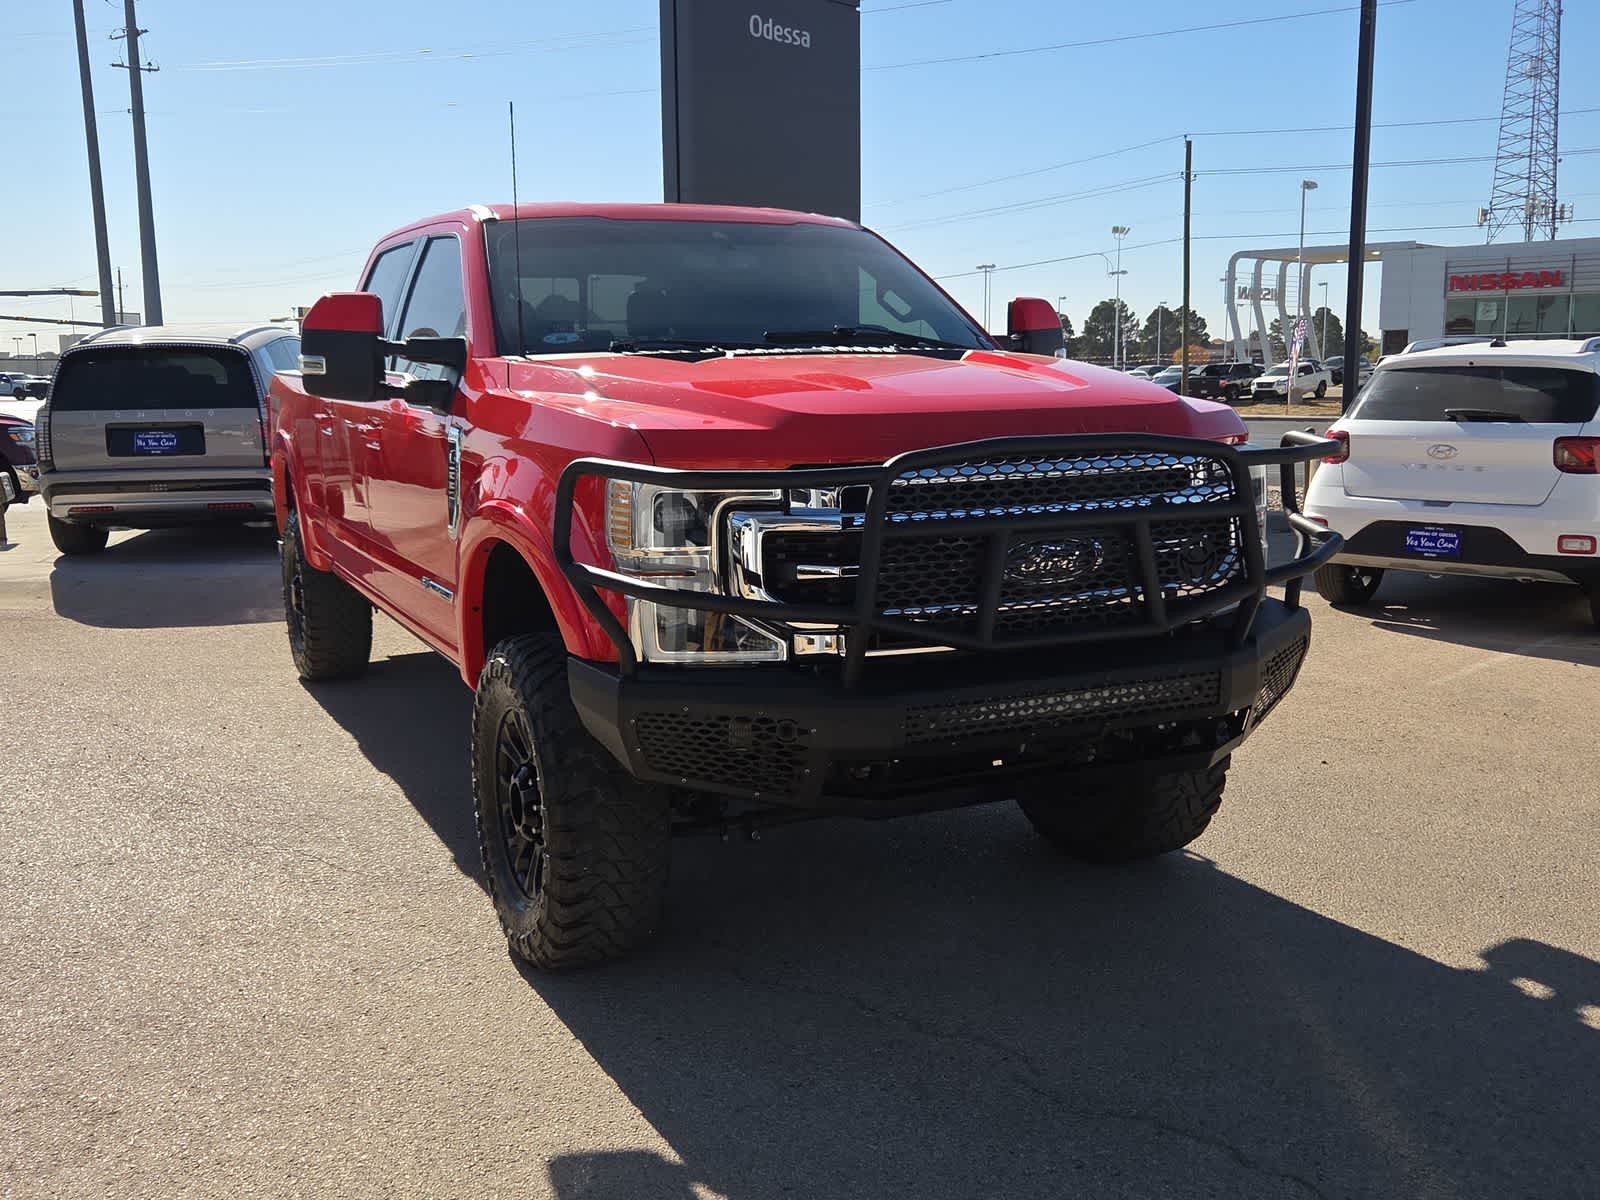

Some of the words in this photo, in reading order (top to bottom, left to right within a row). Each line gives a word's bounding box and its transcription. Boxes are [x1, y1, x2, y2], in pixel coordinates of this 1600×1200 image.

[749, 14, 811, 48] Odessa
[1449, 269, 1562, 291] NISSAN
[1406, 536, 1419, 546] Yes
[1420, 536, 1436, 547] You
[1436, 538, 1459, 549] Can!
